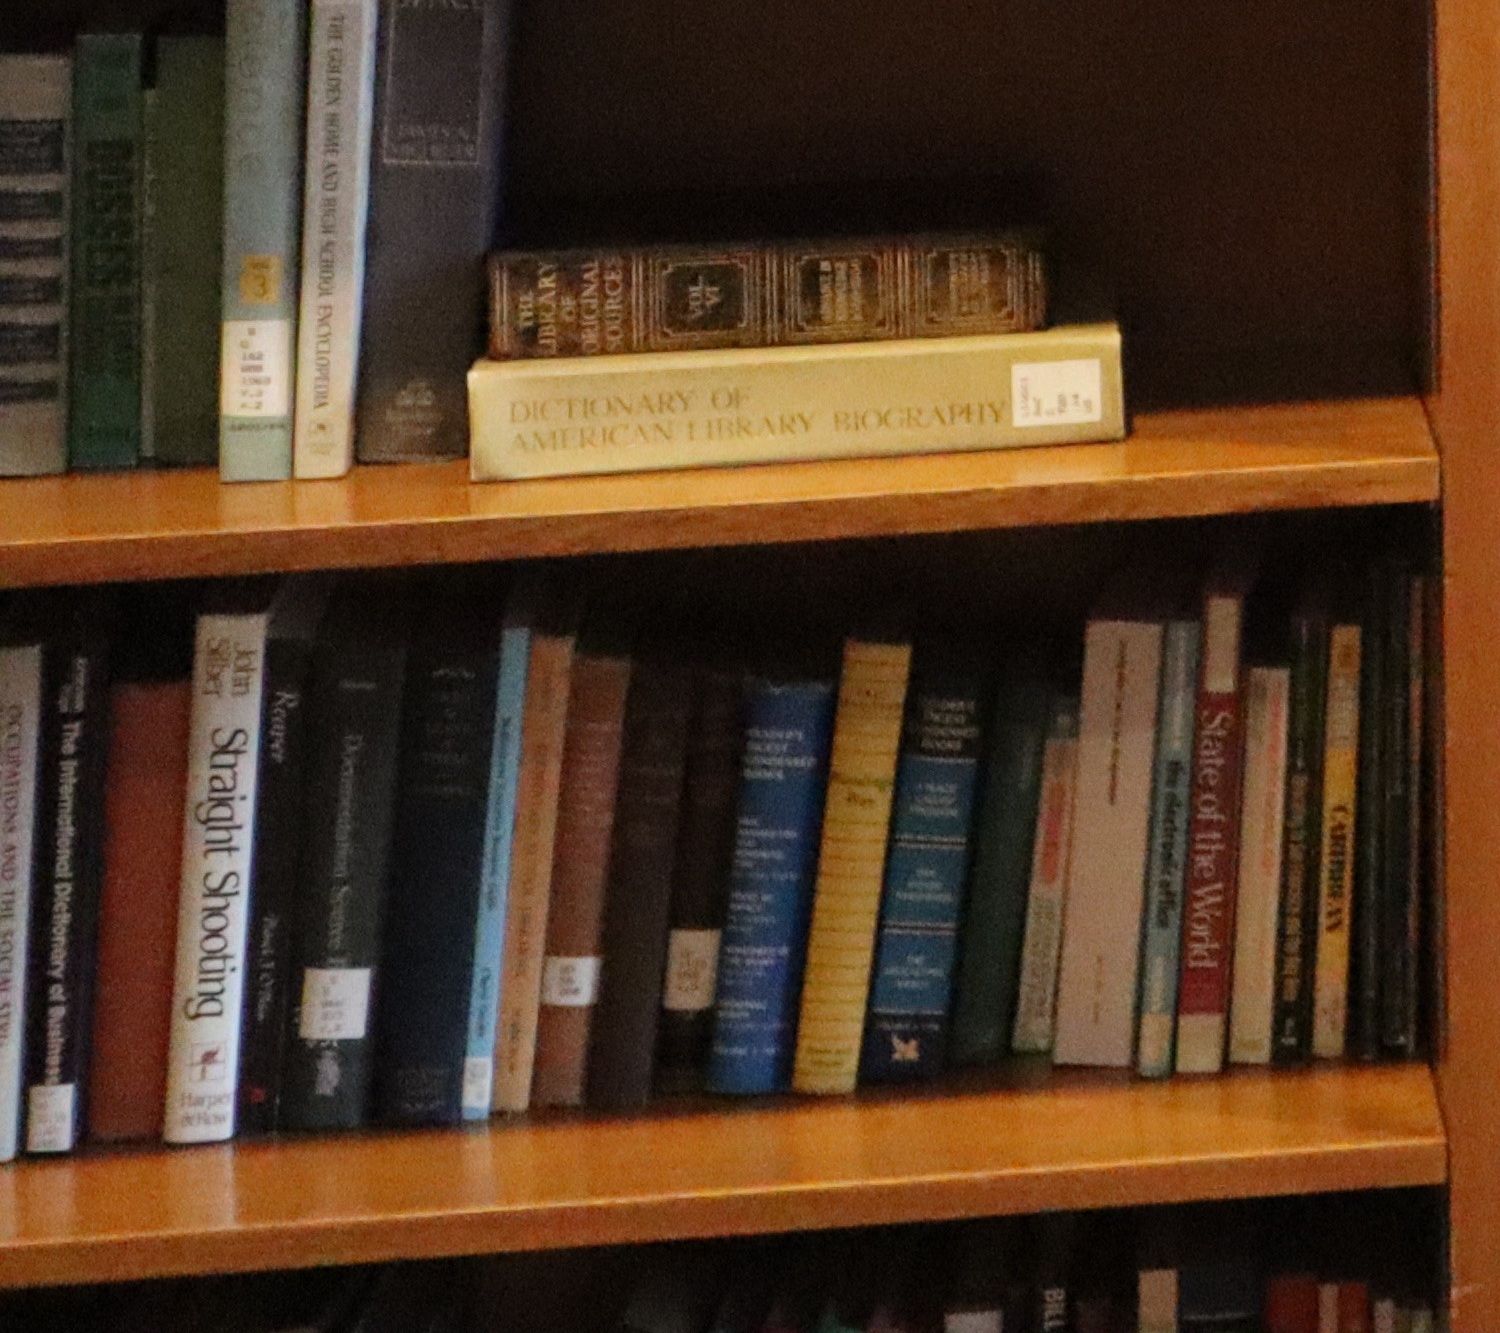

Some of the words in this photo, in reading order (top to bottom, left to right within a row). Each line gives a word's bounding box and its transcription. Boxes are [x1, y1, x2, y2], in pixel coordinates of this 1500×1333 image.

[325, 12, 346, 42] THE
[324, 46, 345, 107] GOLDEN
[321, 111, 342, 156] HOME
[320, 158, 341, 193] AND
[319, 195, 339, 237] HIGH
[317, 238, 338, 298] SCHOOL
[537, 262, 558, 354] LIBRARY
[580, 260, 600, 354] ORIGINAL
[312, 301, 335, 413] ENCYCLOPEDIA
[508, 388, 695, 426] DICTIONARY
[711, 386, 751, 410] OF
[508, 421, 677, 454] AMERICAN
[687, 411, 814, 442] LIBRARY
[832, 398, 1005, 431] BIOGRAPHY
[200, 639, 232, 697] Silber
[230, 644, 258, 696] John
[61, 719, 82, 754] The
[1196, 710, 1232, 787] State
[56, 758, 80, 879] International
[195, 726, 249, 861] Straight
[1196, 793, 1227, 824] of
[1194, 833, 1225, 880] the
[50, 881, 75, 976] Dictionary
[184, 869, 240, 1021] Shooting
[1188, 881, 1224, 971] World
